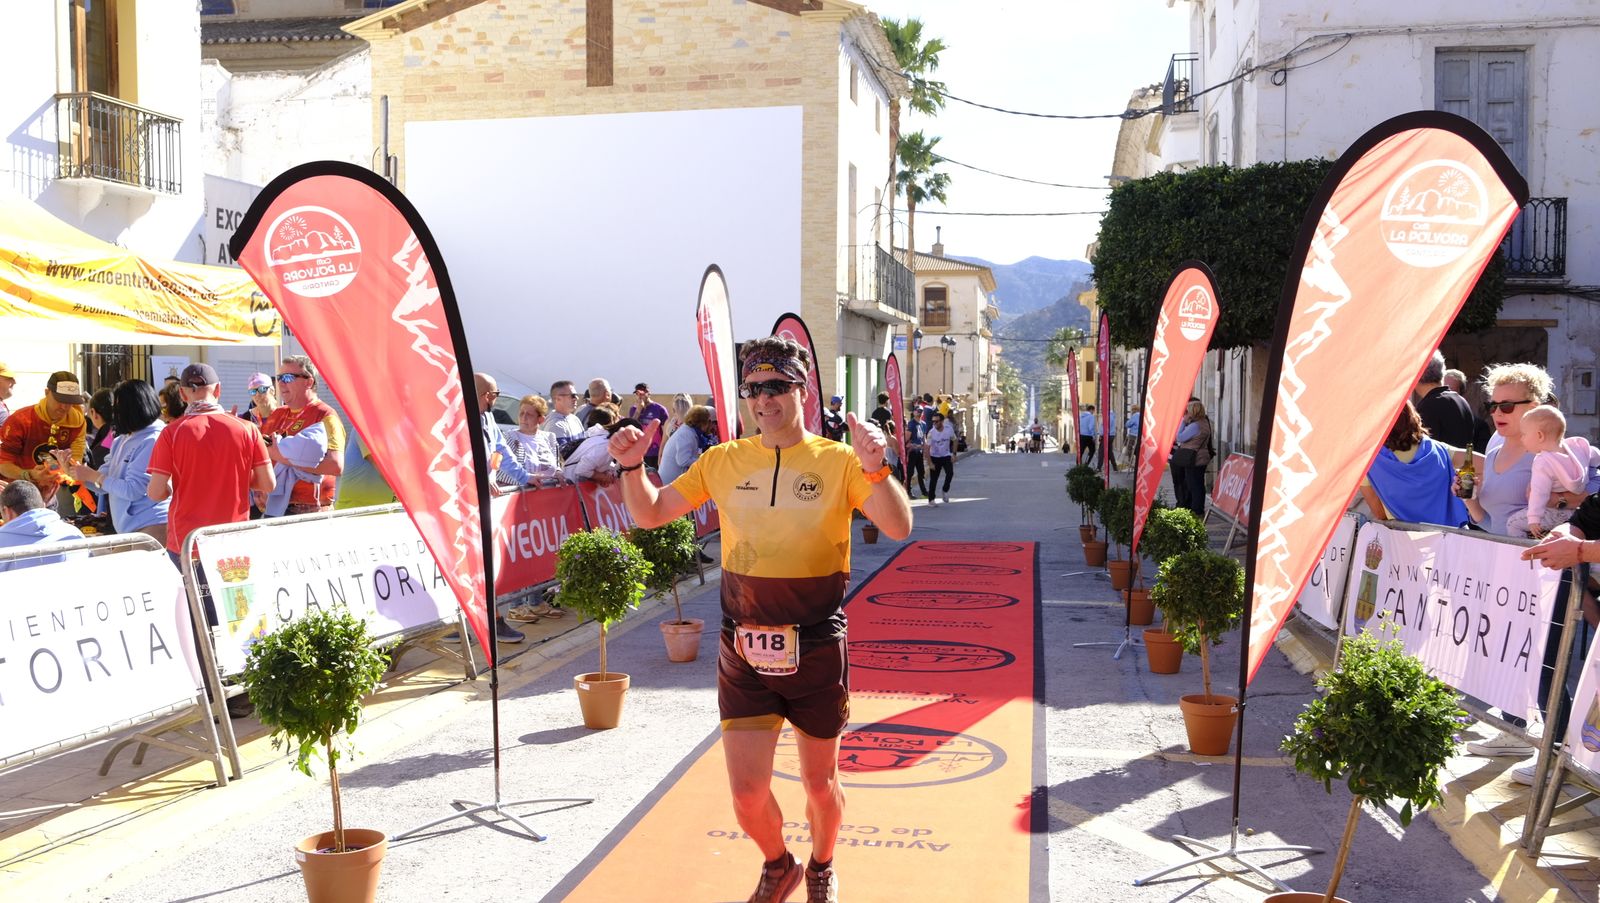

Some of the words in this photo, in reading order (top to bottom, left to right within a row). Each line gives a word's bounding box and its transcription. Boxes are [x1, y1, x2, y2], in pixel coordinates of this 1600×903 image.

[216, 207, 246, 231] EXC
[1390, 230, 1406, 241] LA
[1408, 231, 1469, 245] POLVORA
[501, 514, 569, 563] VEOLIA
[273, 542, 410, 577] AYUNTAMENTO
[123, 591, 154, 617] DE
[276, 561, 447, 623] CANTORIA
[1518, 591, 1537, 616] DE
[744, 632, 785, 651] 118
[1376, 587, 1532, 673] CANTORIA
[707, 830, 951, 852] Ayuntamito
[891, 827, 933, 837] de
